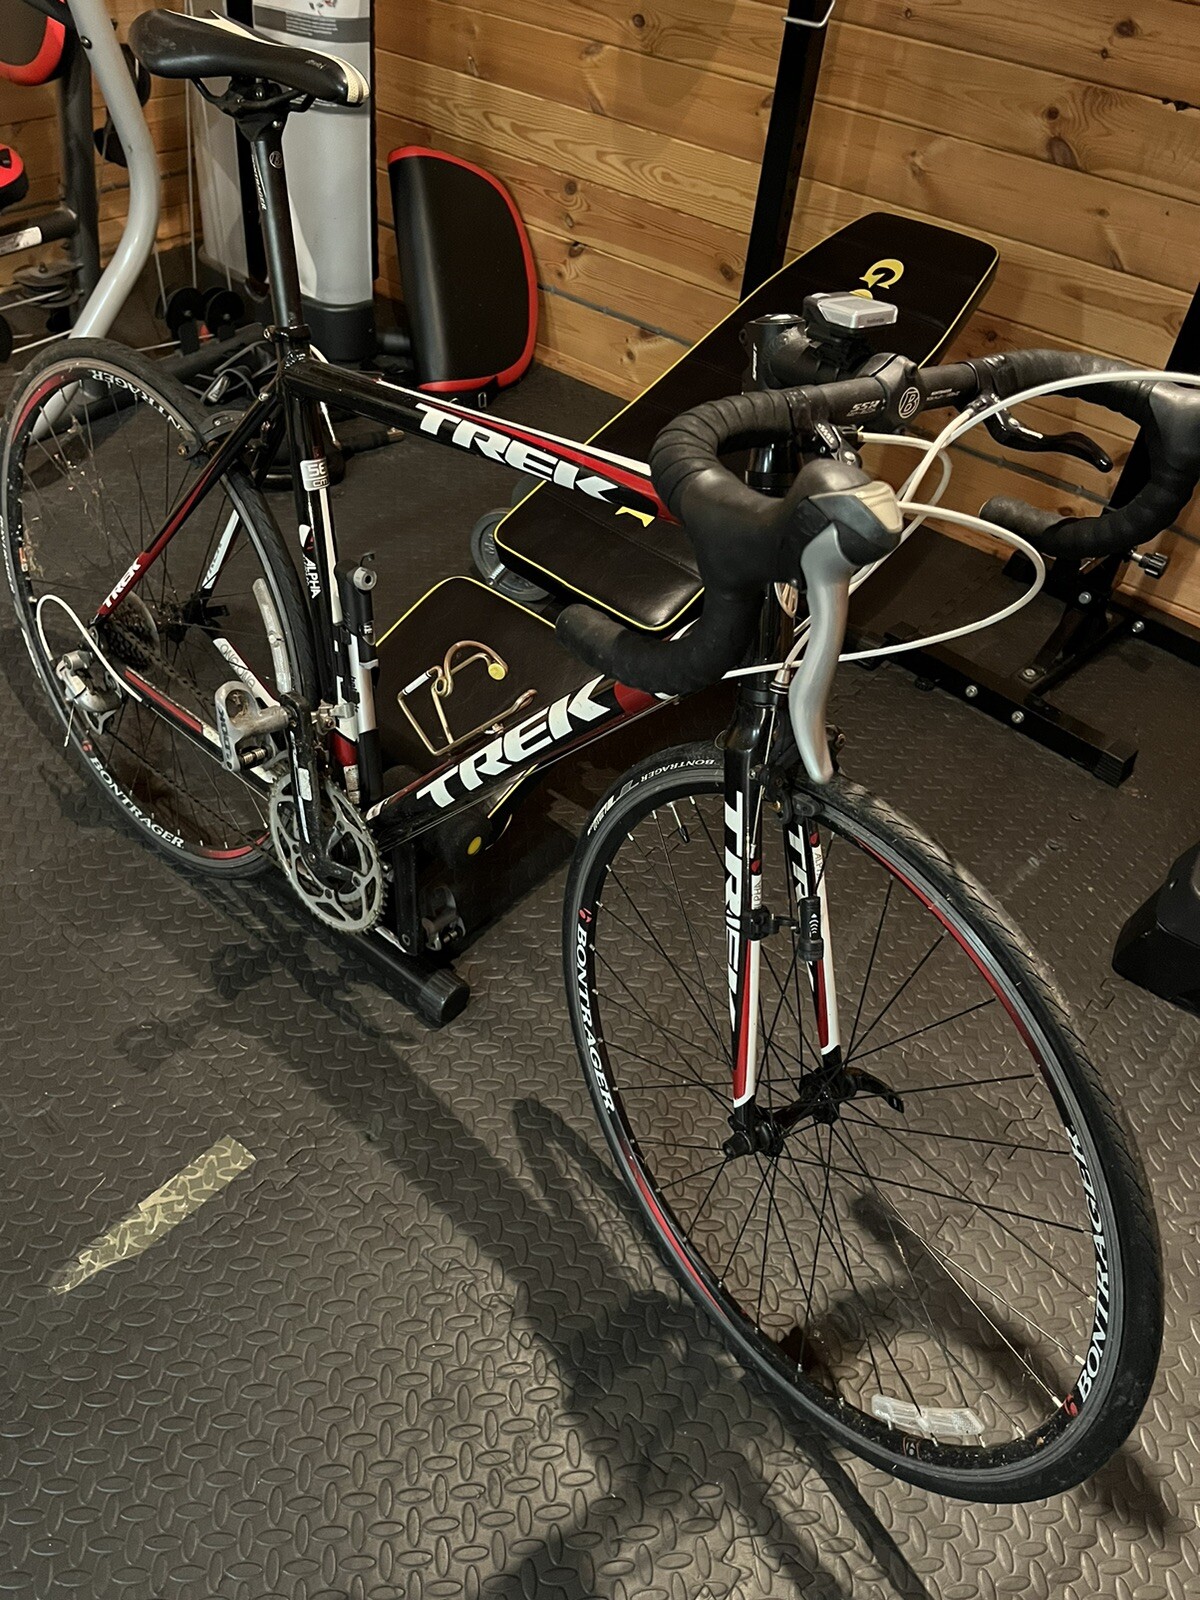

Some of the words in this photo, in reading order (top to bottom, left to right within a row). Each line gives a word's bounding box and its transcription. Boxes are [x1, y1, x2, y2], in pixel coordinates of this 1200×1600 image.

[415, 402, 618, 505] TREK
[102, 557, 141, 608] TREK
[304, 554, 322, 599] ALPHA
[416, 674, 611, 808] TREK
[640, 759, 715, 782] BONTRAGER
[90, 757, 185, 849] BONTRAGER
[576, 923, 616, 1114] BONTRAGER
[1065, 1126, 1109, 1402] BONTRAGER
